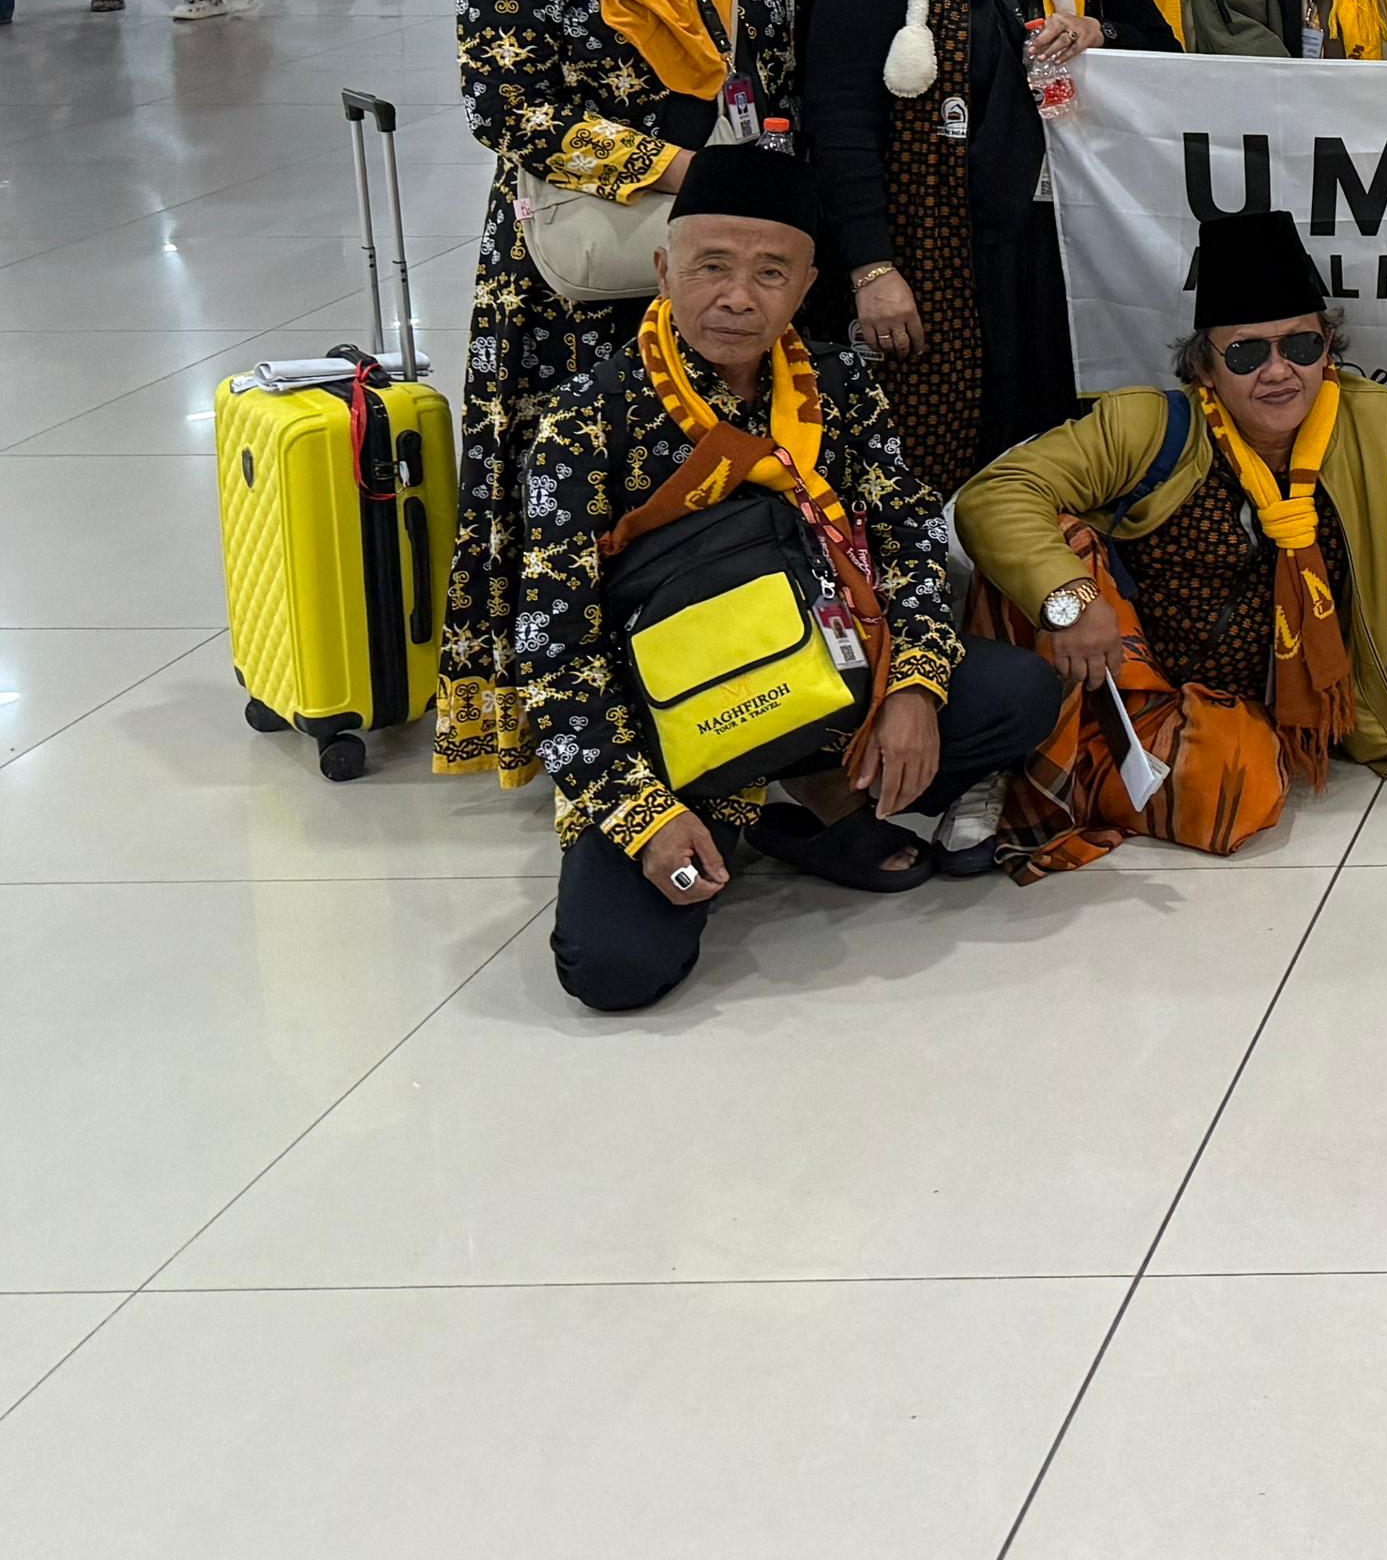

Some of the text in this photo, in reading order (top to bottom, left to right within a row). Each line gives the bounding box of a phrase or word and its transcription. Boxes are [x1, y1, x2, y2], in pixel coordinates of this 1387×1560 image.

[696, 682, 793, 736] MAGHFIROH
[714, 721, 739, 735] TOUR
[749, 700, 782, 721] TRAVEL
